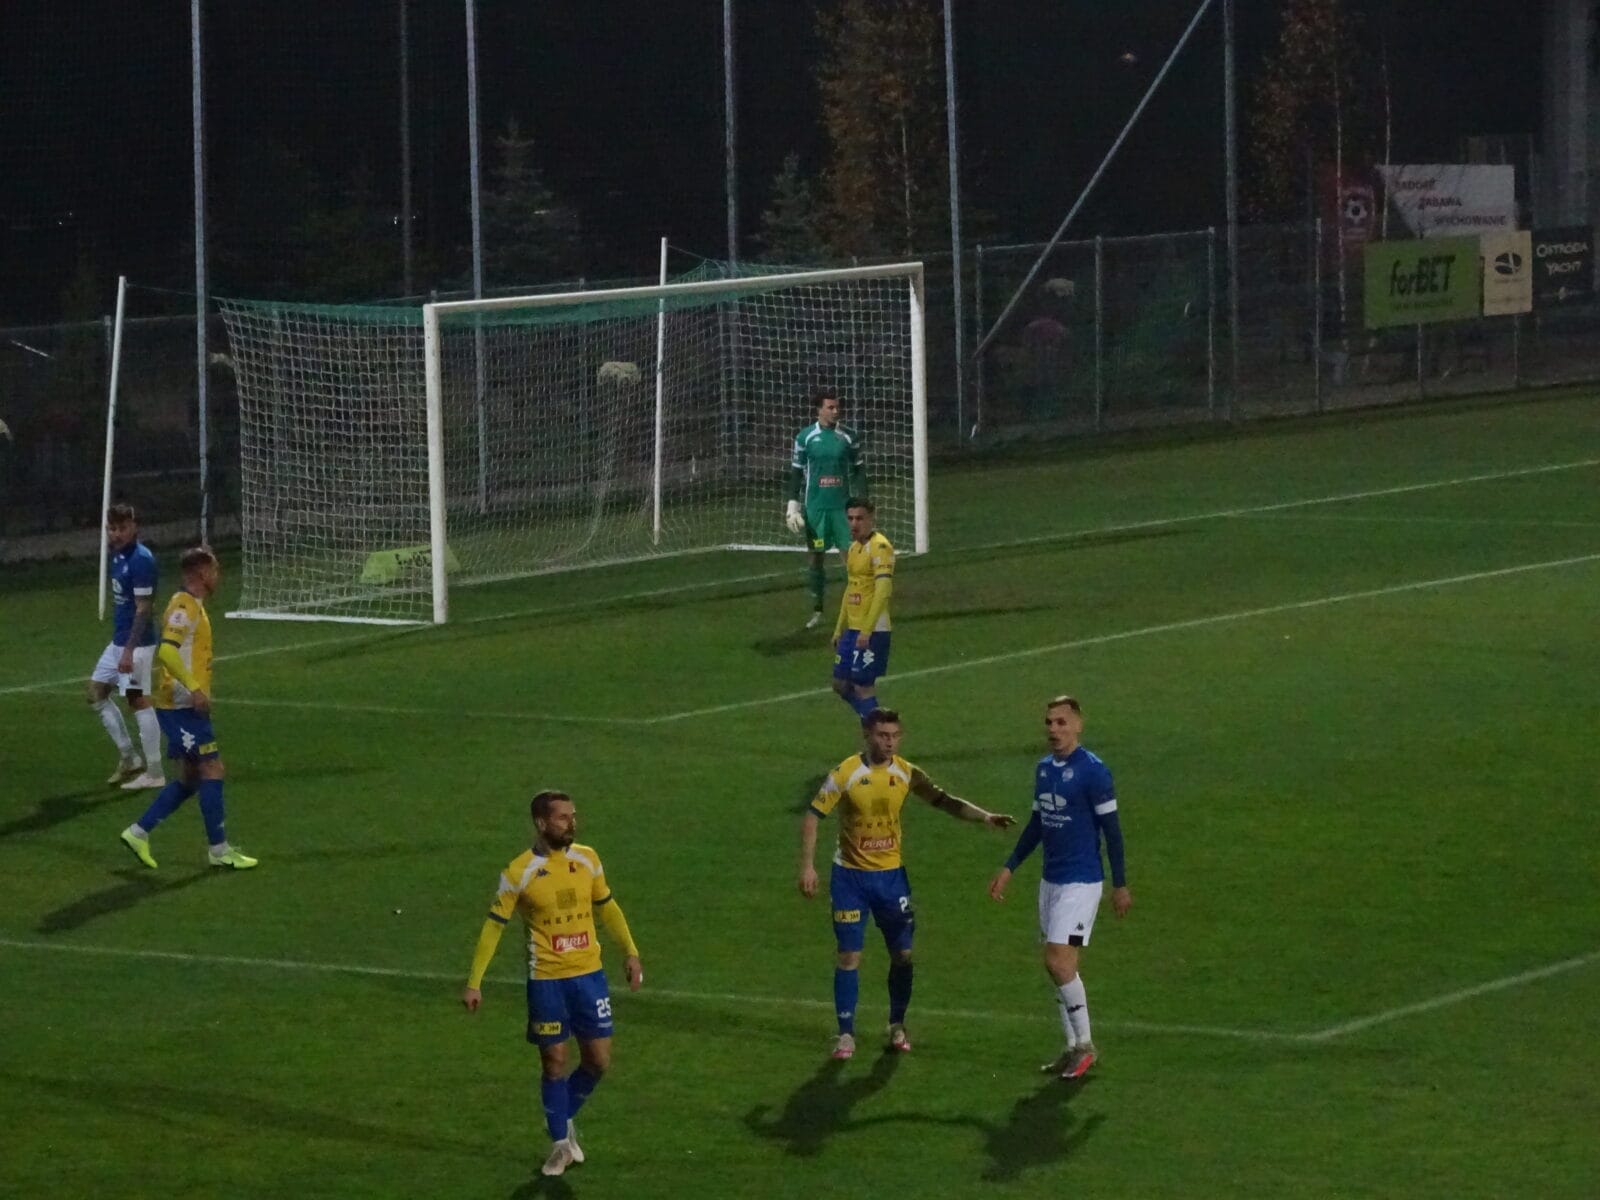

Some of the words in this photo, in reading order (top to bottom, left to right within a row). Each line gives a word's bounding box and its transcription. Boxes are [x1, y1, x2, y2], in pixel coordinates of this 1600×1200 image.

[1417, 197, 1462, 211] ZABAWA
[1389, 255, 1456, 297] forBET
[1544, 260, 1582, 278] YACHT
[595, 997, 612, 1018] 25
